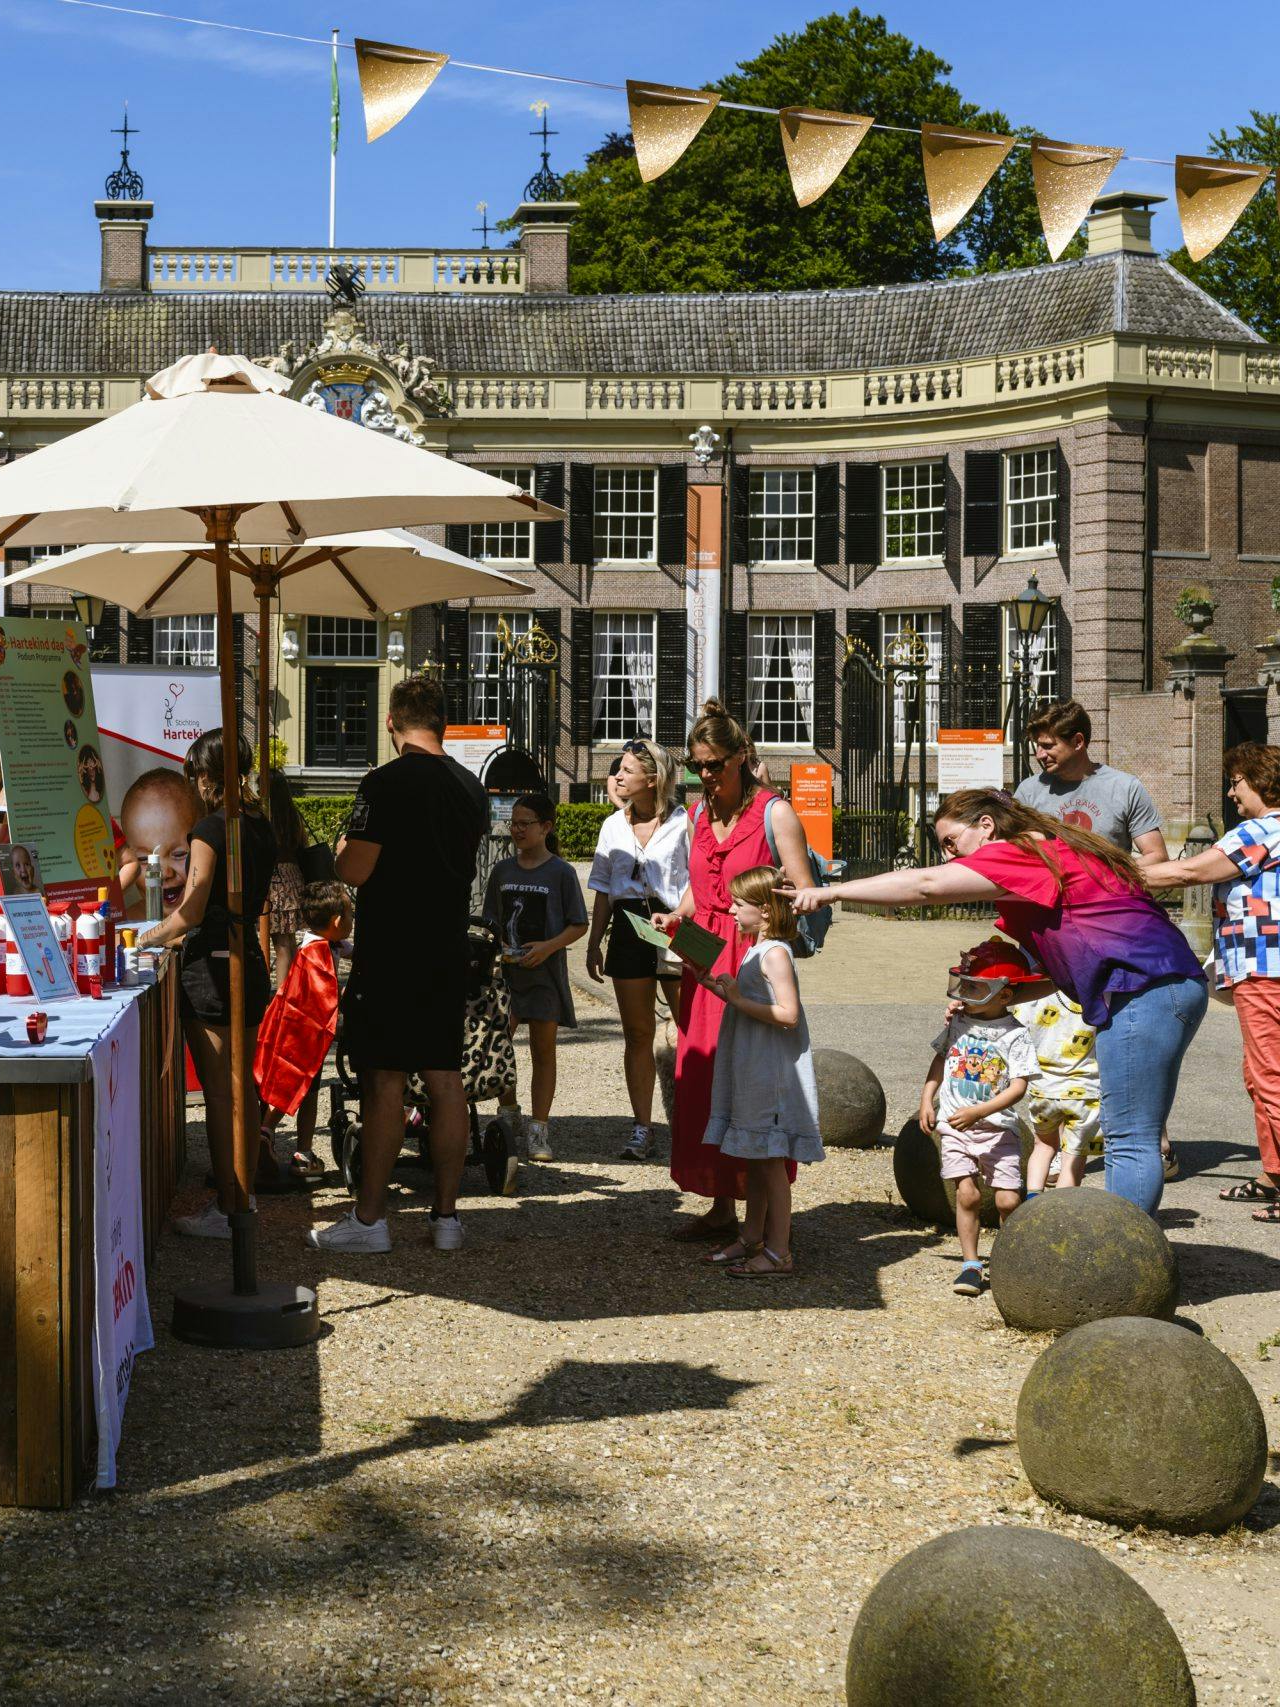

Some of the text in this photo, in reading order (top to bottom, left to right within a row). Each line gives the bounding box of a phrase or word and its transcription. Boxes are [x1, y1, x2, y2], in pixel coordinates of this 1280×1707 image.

[9, 636, 65, 653] Hartekind dag
[692, 634, 709, 709] Groenevel
[175, 719, 200, 727] Stichting
[163, 729, 204, 740] Harteki
[519, 884, 550, 895] STYLES
[950, 1079, 993, 1102] FUN!
